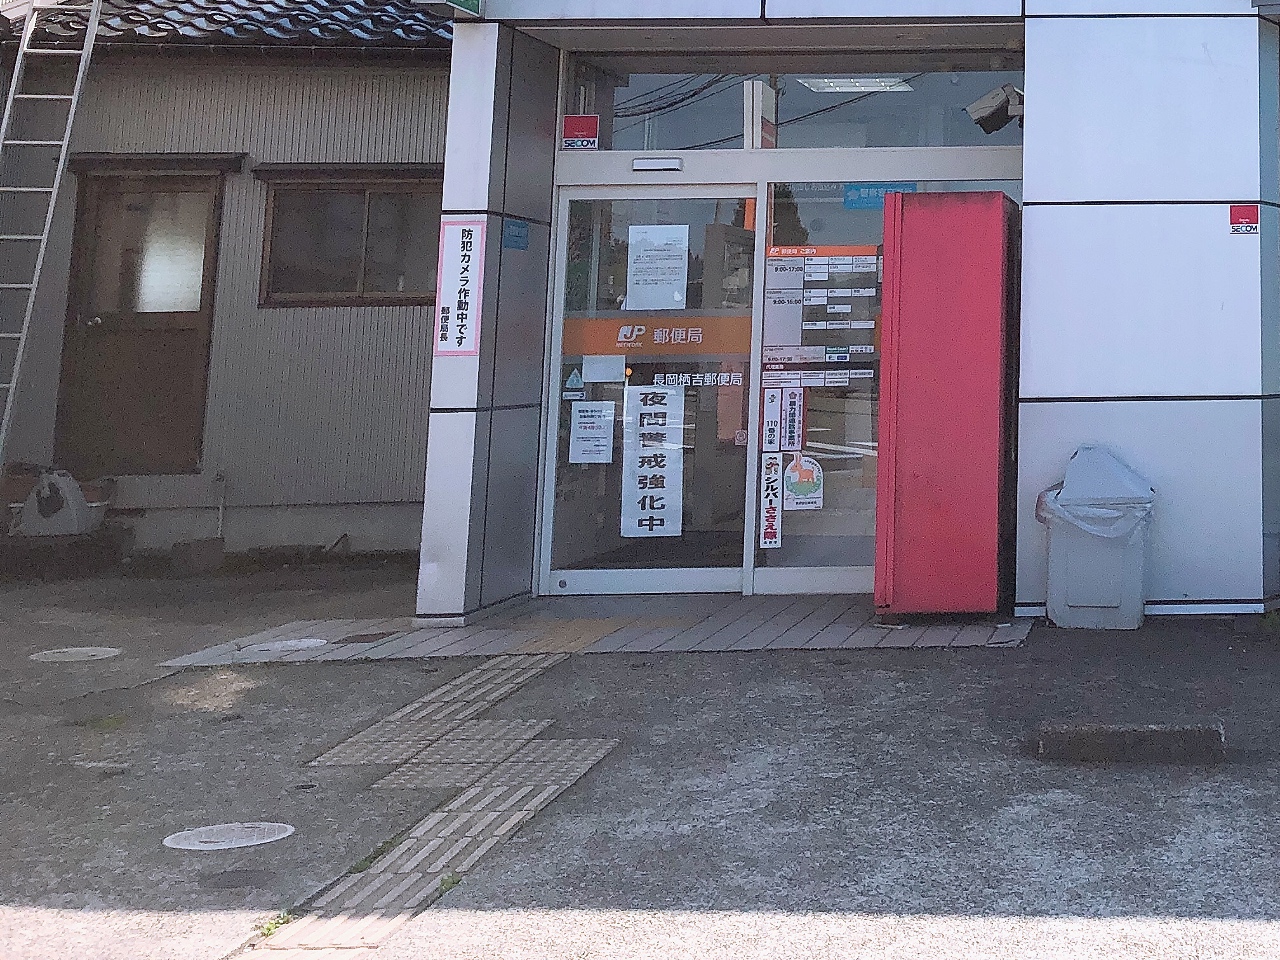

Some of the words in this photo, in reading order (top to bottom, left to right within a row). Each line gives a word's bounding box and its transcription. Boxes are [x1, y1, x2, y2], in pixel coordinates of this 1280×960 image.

[564, 139, 596, 147] SECOM
[456, 228, 473, 347] 防犯カメラ作動中です
[440, 306, 450, 341] 郵便局長
[653, 327, 703, 344] 郵便局
[653, 373, 743, 387] 長岡栖吉郵便局
[636, 391, 668, 531] 夜間警戒強化中
